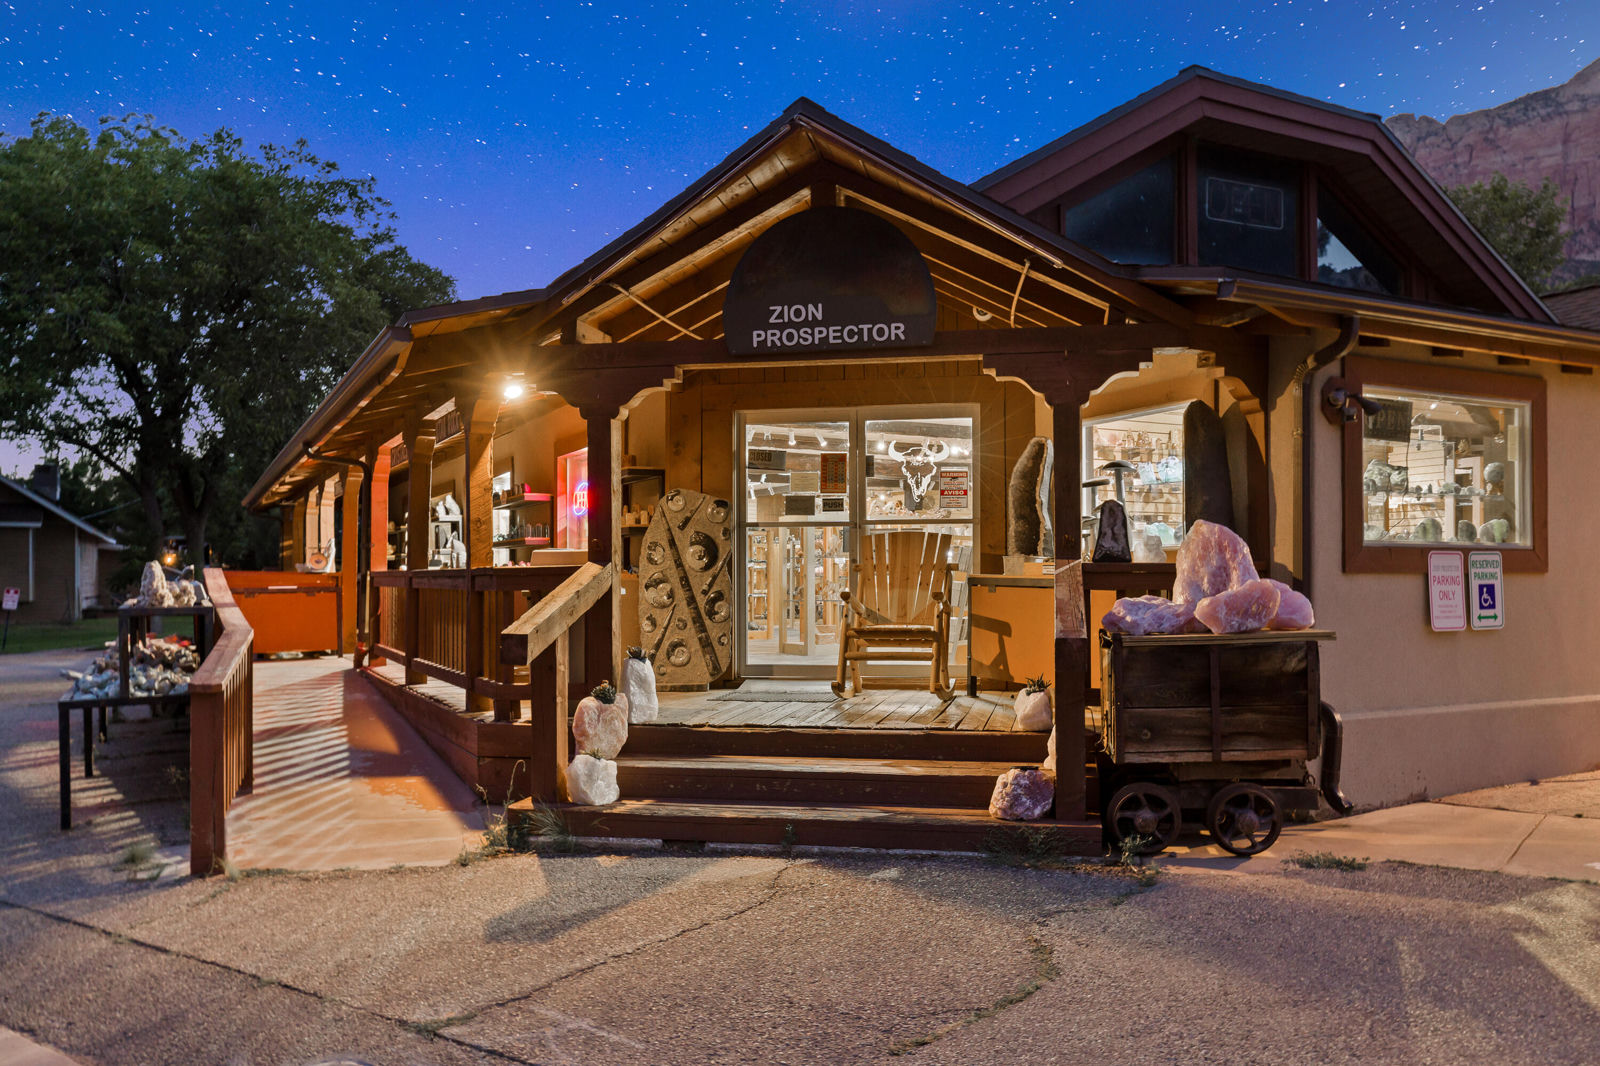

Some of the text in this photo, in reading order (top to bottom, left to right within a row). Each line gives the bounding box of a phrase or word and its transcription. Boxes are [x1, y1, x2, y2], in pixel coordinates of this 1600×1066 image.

[769, 302, 823, 324] ZION
[753, 322, 906, 348] PROSPECTOR
[749, 451, 772, 462] CLOSED
[1471, 560, 1499, 569] RESERVED
[1432, 575, 1460, 586] PARKING
[1473, 571, 1498, 581] PARKING
[1438, 590, 1456, 601] ONLY
